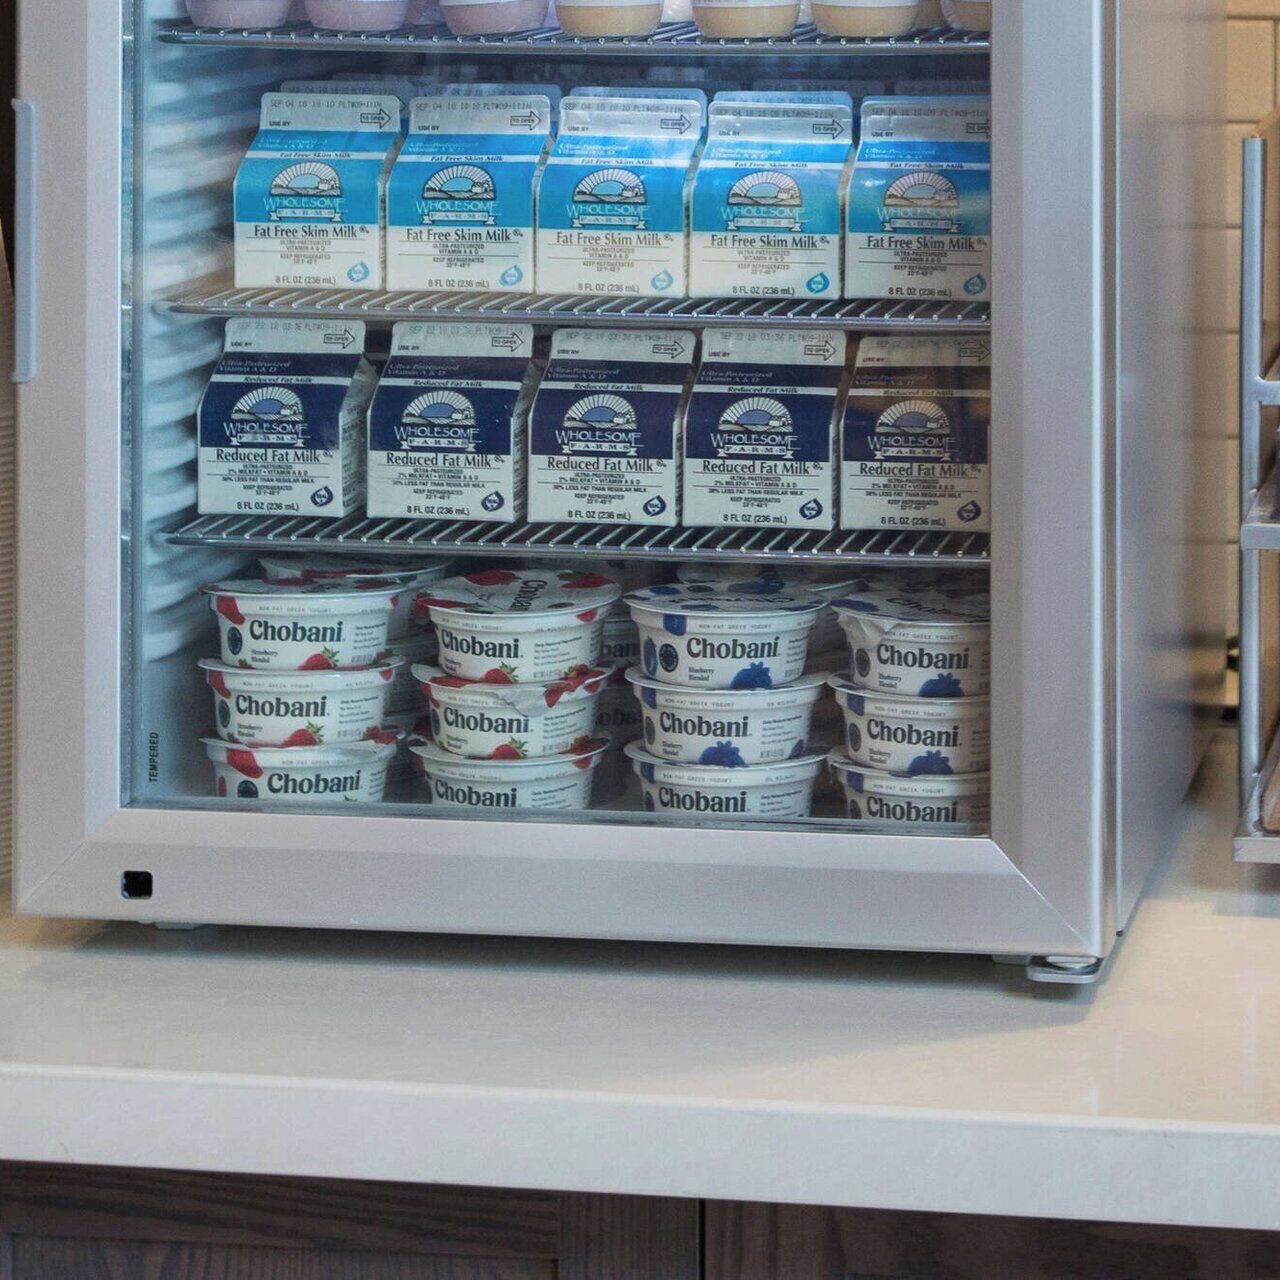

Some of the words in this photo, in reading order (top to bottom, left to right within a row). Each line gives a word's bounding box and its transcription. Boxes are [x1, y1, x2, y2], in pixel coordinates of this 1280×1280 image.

[255, 225, 270, 237] Fat
[275, 225, 298, 237] Free
[302, 225, 328, 238] Skim
[333, 225, 357, 238] Milk
[407, 228, 423, 240] Fat
[428, 228, 451, 241] Free
[455, 228, 481, 241] Skim
[486, 228, 511, 241] Milk
[557, 232, 573, 244] Fat
[577, 232, 600, 245] Free
[605, 232, 631, 246] Skim
[636, 233, 661, 246] Milk
[711, 235, 728, 246] Fat
[732, 235, 756, 247] Free
[761, 235, 787, 248] Skim
[792, 236, 817, 249] Milk
[867, 235, 884, 248] Fat
[888, 236, 913, 249] Free
[916, 236, 944, 250] Skim
[949, 236, 975, 250] Milk
[217, 446, 267, 462] Reduced
[272, 449, 290, 462] Fat
[293, 449, 320, 463] Milk
[386, 451, 438, 466] Reduced
[443, 454, 460, 467] Fat
[464, 454, 491, 468] Milk
[548, 456, 599, 470] Reduced
[604, 458, 621, 471] Fat
[626, 458, 653, 472] Milk
[703, 459, 756, 474] Reduced
[760, 461, 777, 474] Fat
[782, 461, 810, 475] Milk
[860, 462, 913, 476] Reduced
[918, 464, 935, 477] Fat
[940, 464, 968, 477] Milk
[249, 620, 344, 643] Chobani
[441, 629, 520, 659] Chobani
[686, 636, 780, 659] Chobani
[877, 643, 970, 669] Chobani
[235, 695, 327, 718] Chobani
[444, 707, 530, 733] Chobani
[660, 711, 749, 738] Chobani
[867, 718, 960, 748] Chobani
[149, 731, 159, 783] TEMPERED
[267, 769, 361, 795] Chobani
[435, 778, 517, 808] Chobani
[659, 786, 747, 813] Chobani
[867, 796, 958, 823] Chobani
